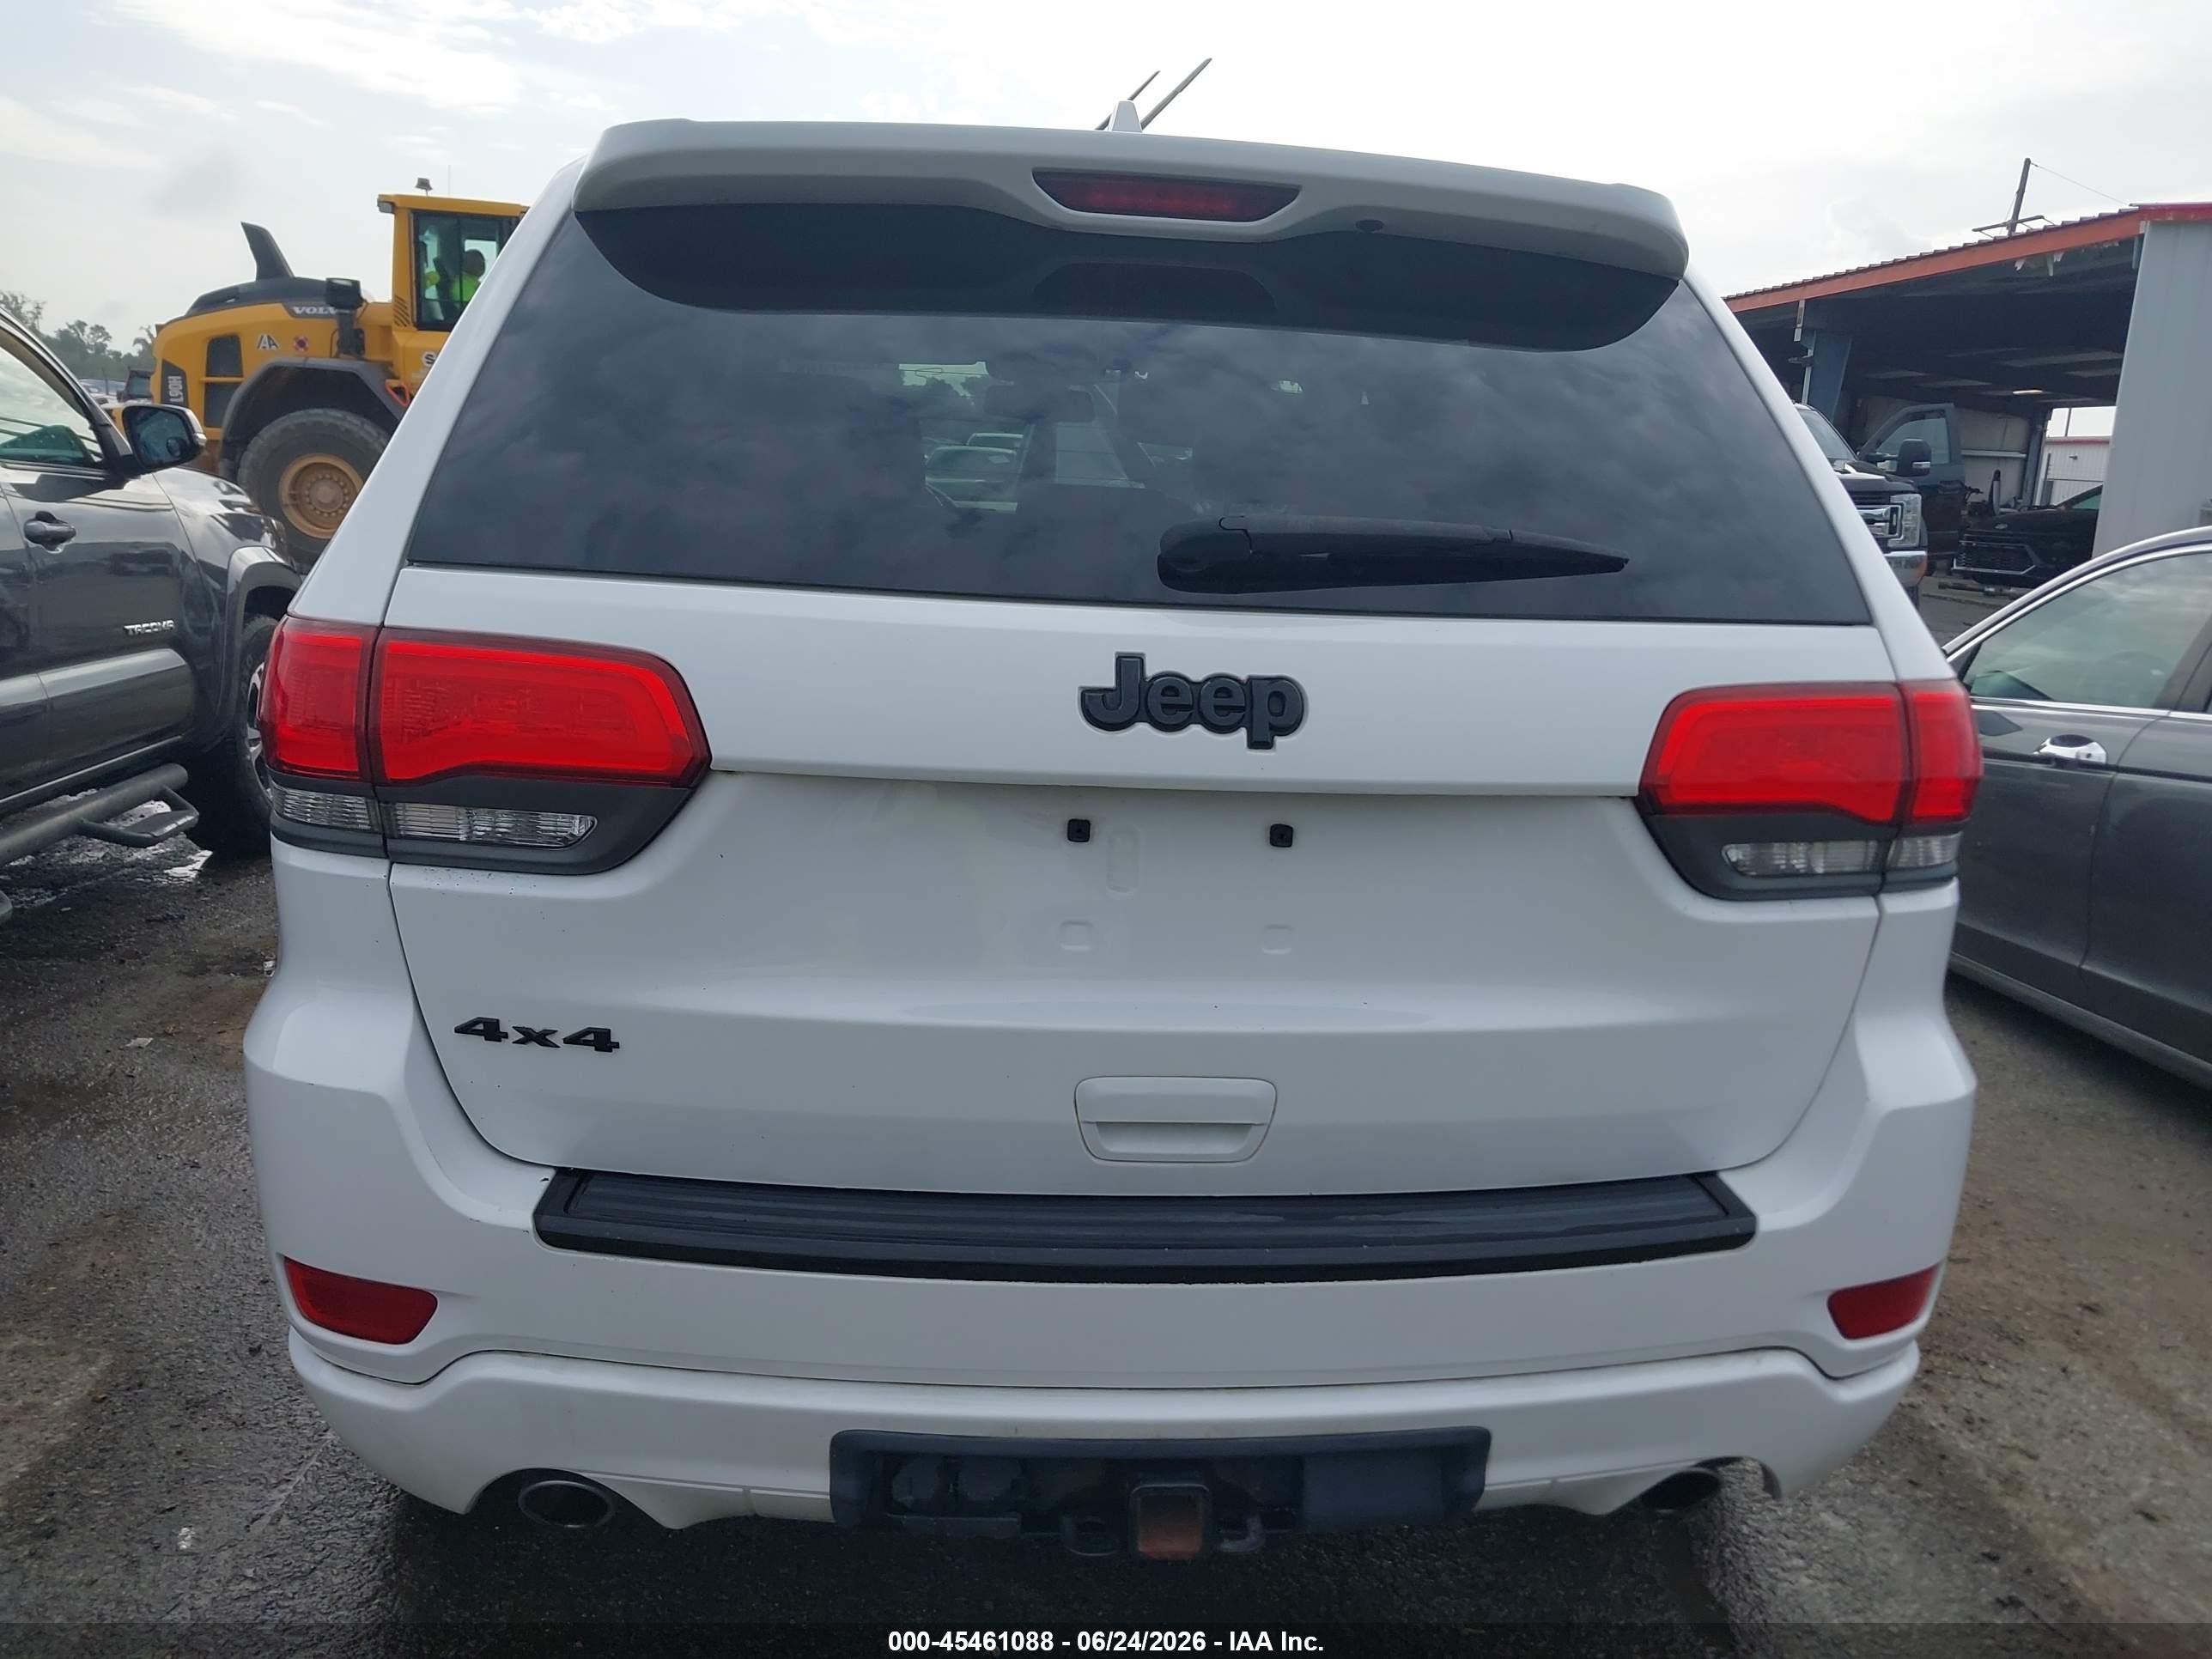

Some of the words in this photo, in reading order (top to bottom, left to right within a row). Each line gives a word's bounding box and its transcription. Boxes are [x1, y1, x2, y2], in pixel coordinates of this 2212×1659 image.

[293, 306, 337, 315] VOLV
[167, 375, 184, 403] L90H
[124, 620, 174, 635] TACOMA
[1079, 653, 1307, 750] Jeep
[454, 1017, 620, 1053] 4x4
